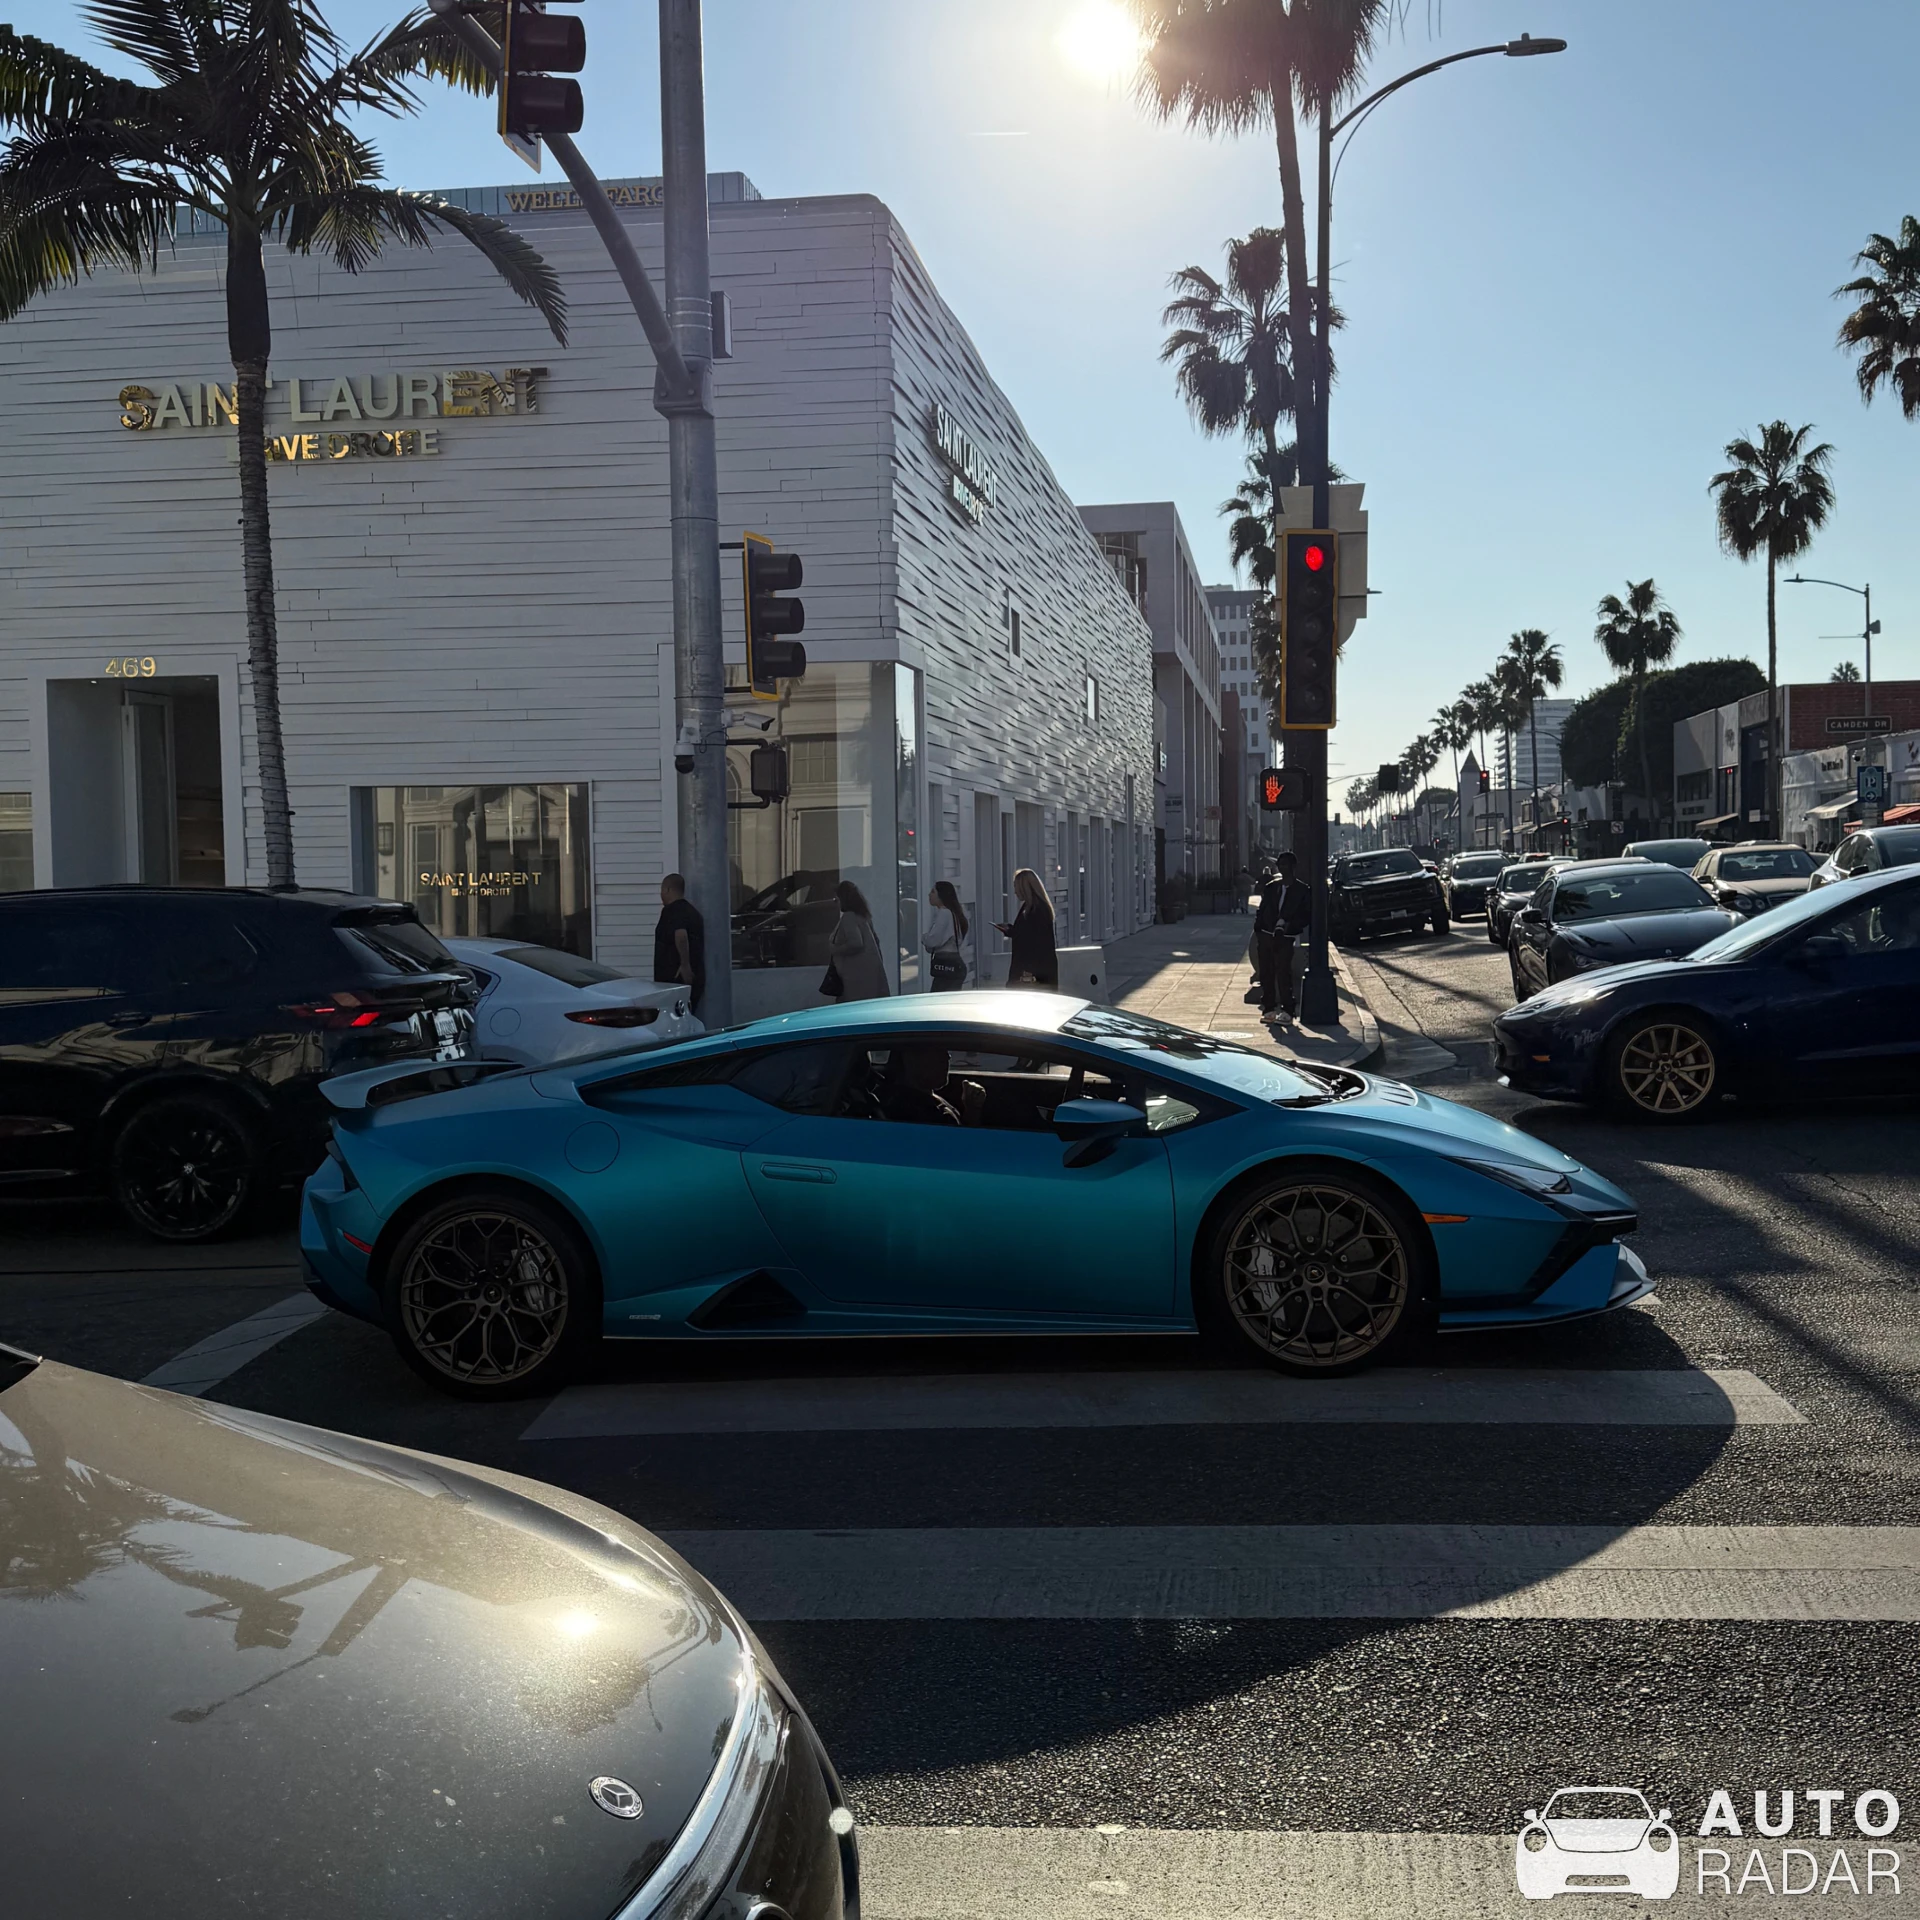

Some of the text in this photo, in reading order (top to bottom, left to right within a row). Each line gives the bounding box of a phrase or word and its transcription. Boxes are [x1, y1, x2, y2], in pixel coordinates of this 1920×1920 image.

[506, 184, 664, 212] WELL FARG
[119, 366, 548, 430] SAIN LAURENT
[328, 428, 440, 461] DROITE
[105, 656, 156, 678] 469
[1830, 720, 1887, 729] CAMDEN DR
[420, 872, 542, 886] SAINT LAURENT
